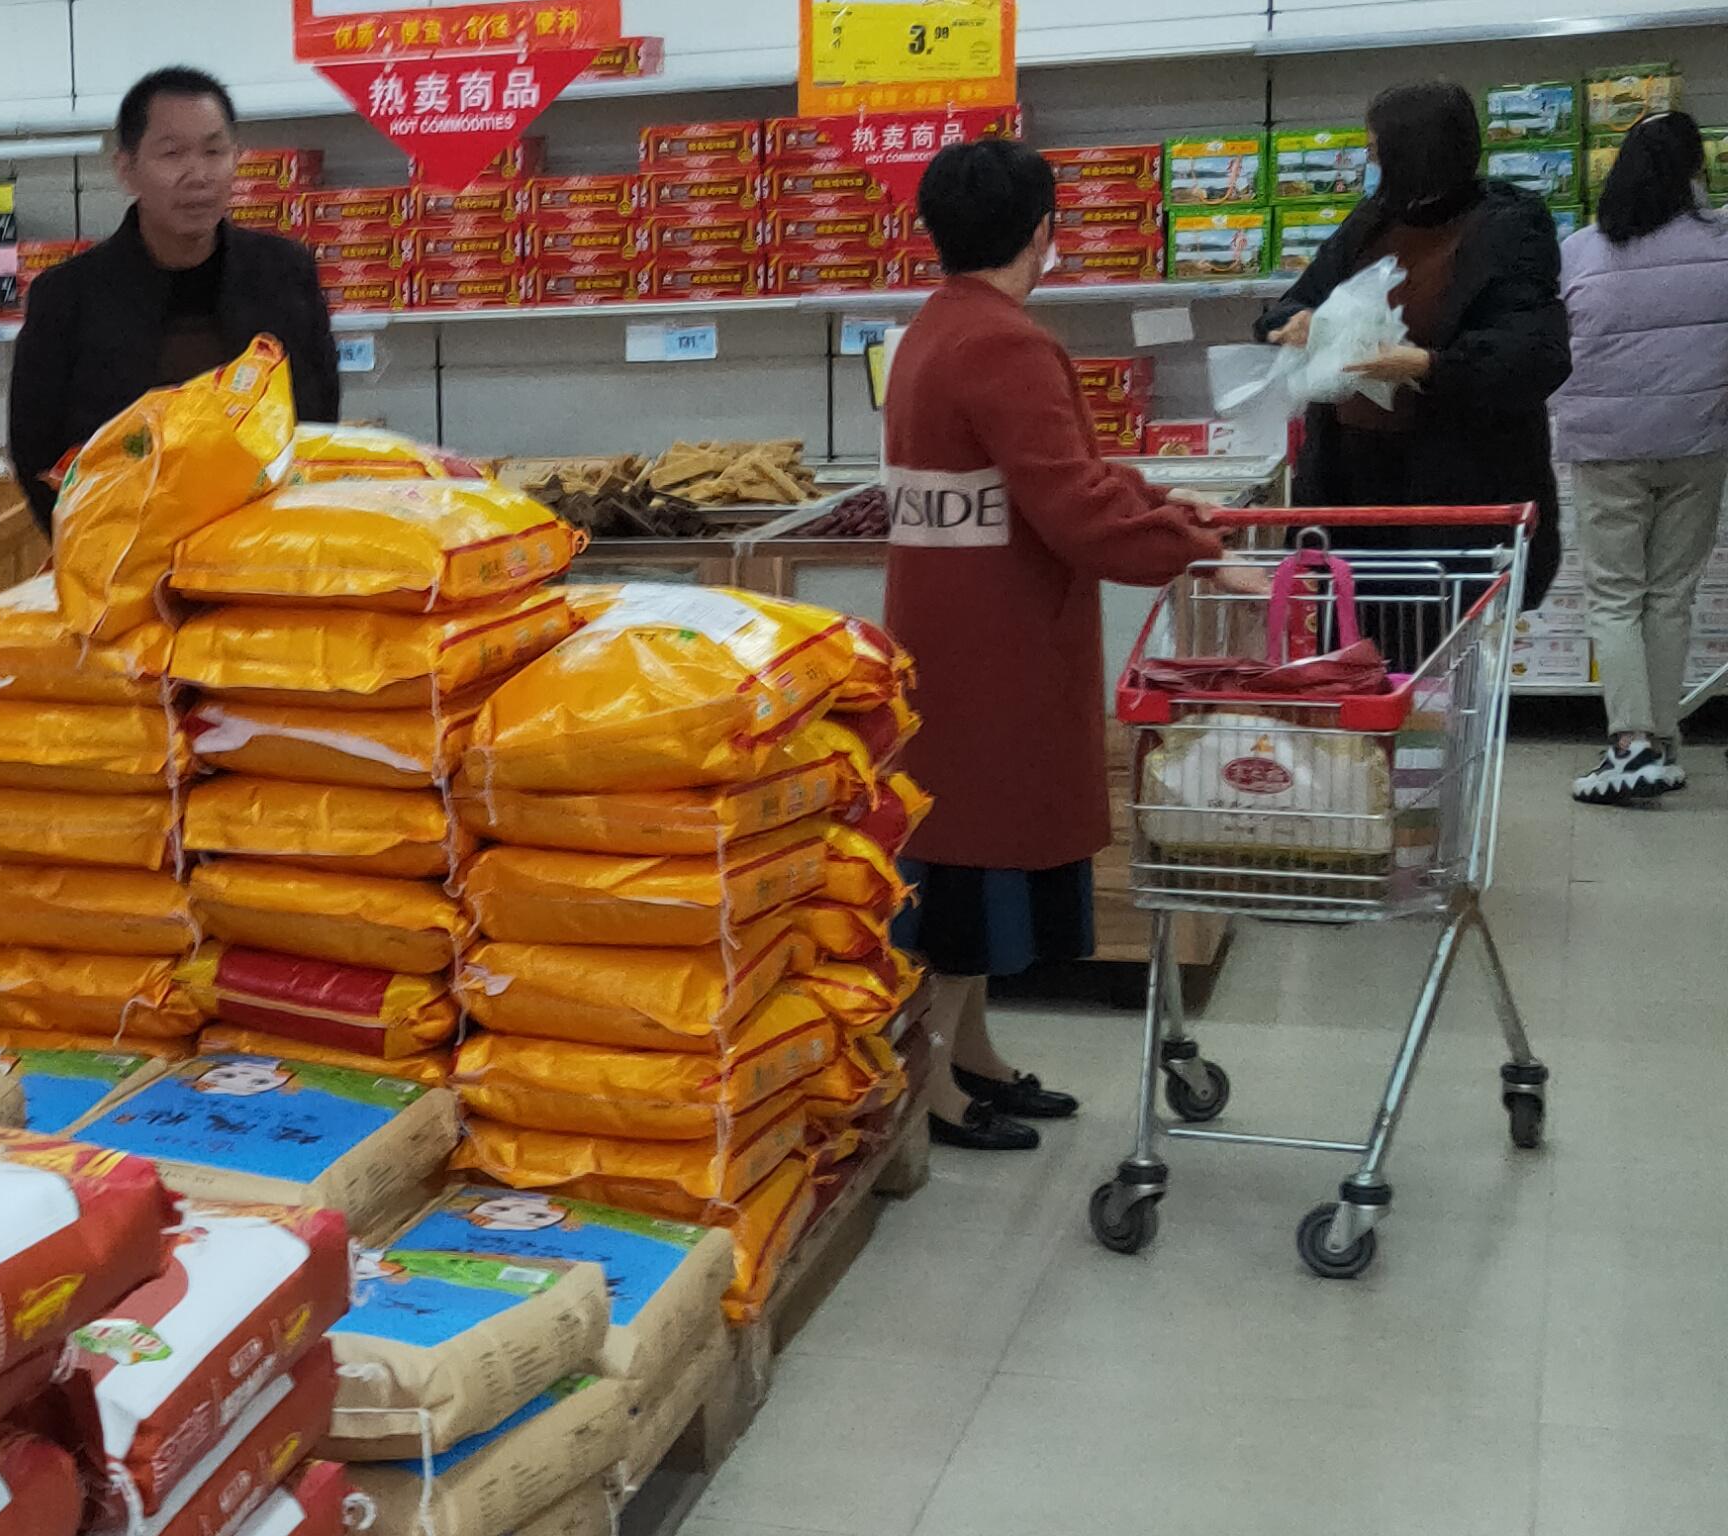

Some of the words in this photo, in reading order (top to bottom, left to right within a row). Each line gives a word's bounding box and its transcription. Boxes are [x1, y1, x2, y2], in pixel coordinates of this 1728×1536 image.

[368, 67, 540, 118] 热卖商品
[388, 117, 418, 136] HOT
[851, 121, 967, 153] 热卖商品
